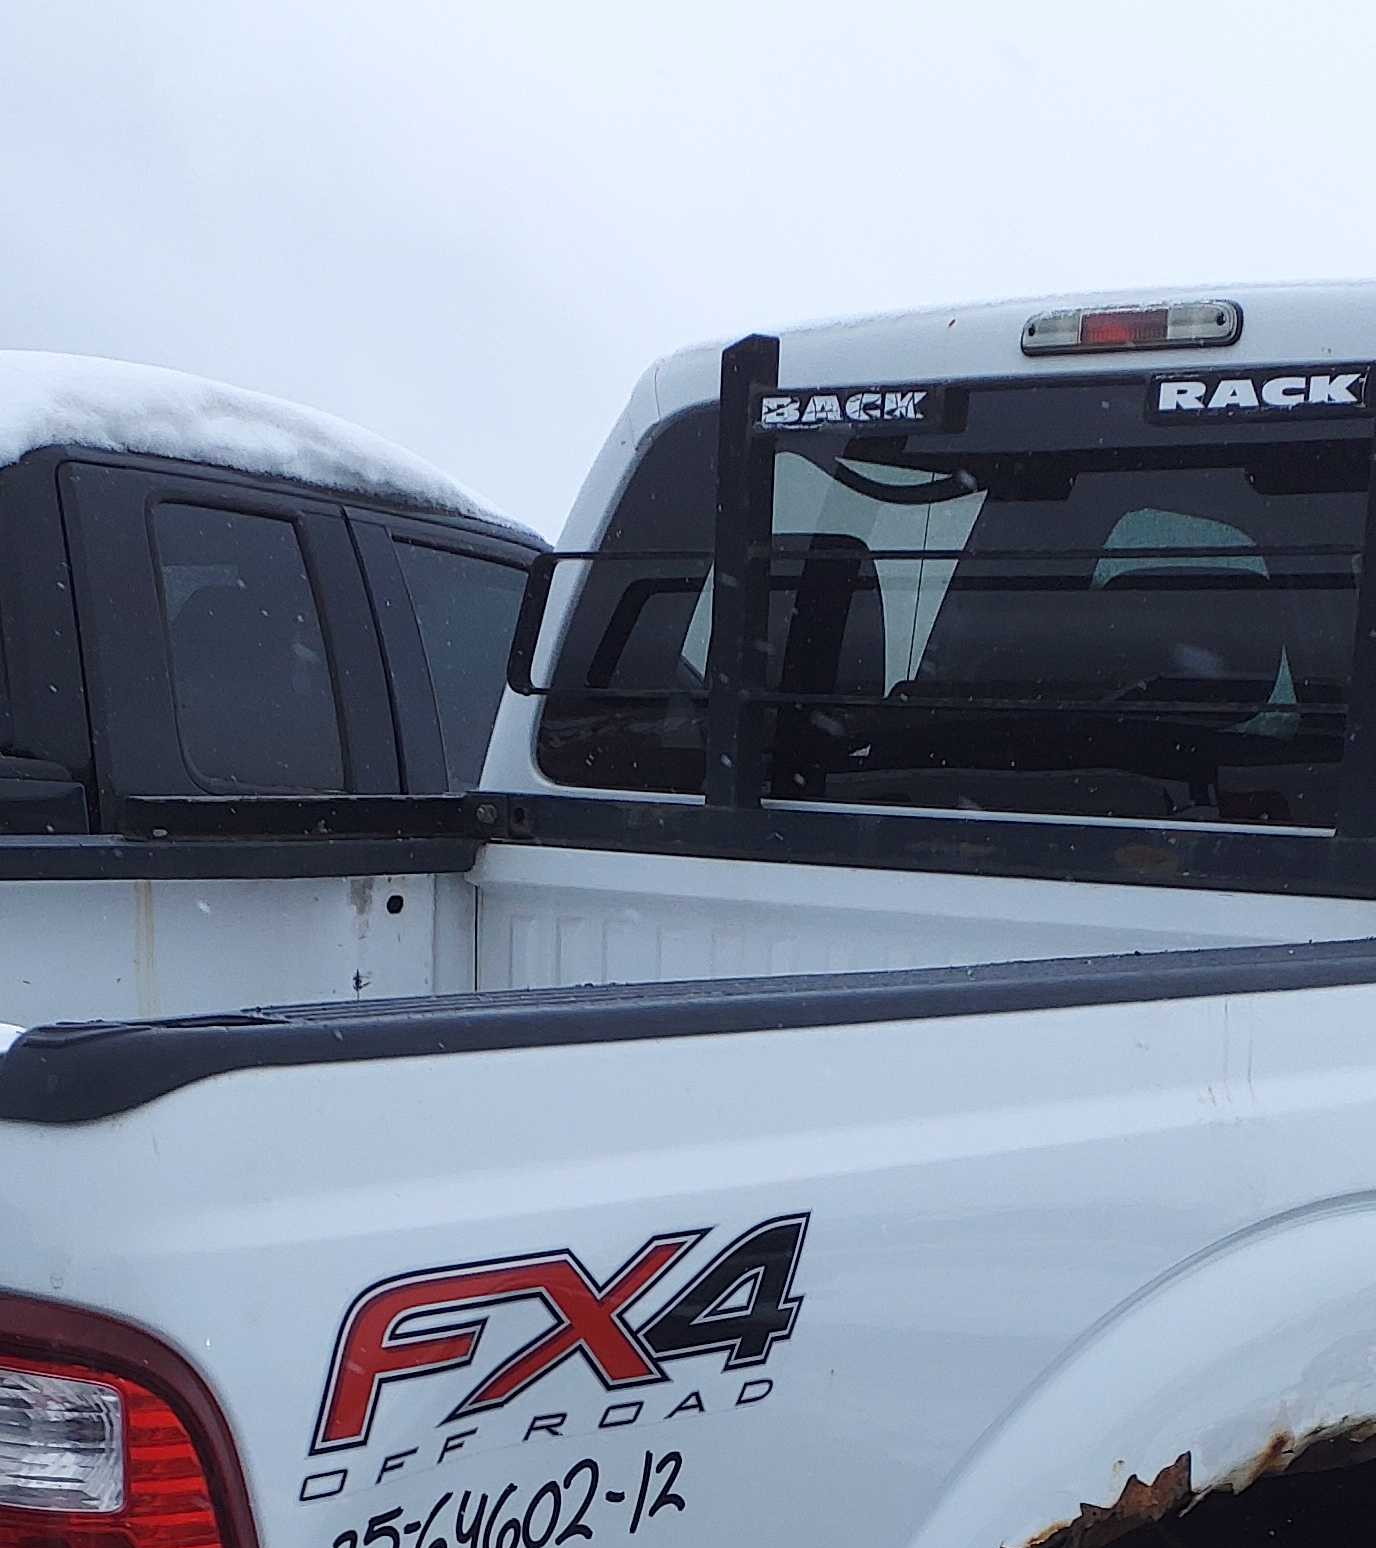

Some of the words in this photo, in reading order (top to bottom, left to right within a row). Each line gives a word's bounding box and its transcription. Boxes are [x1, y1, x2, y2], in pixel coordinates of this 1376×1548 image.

[761, 391, 928, 424] BACK
[1157, 373, 1362, 411] RACK
[308, 1210, 812, 1456] FX4
[298, 1427, 478, 1502] OFF
[522, 1378, 774, 1442] ROAD
